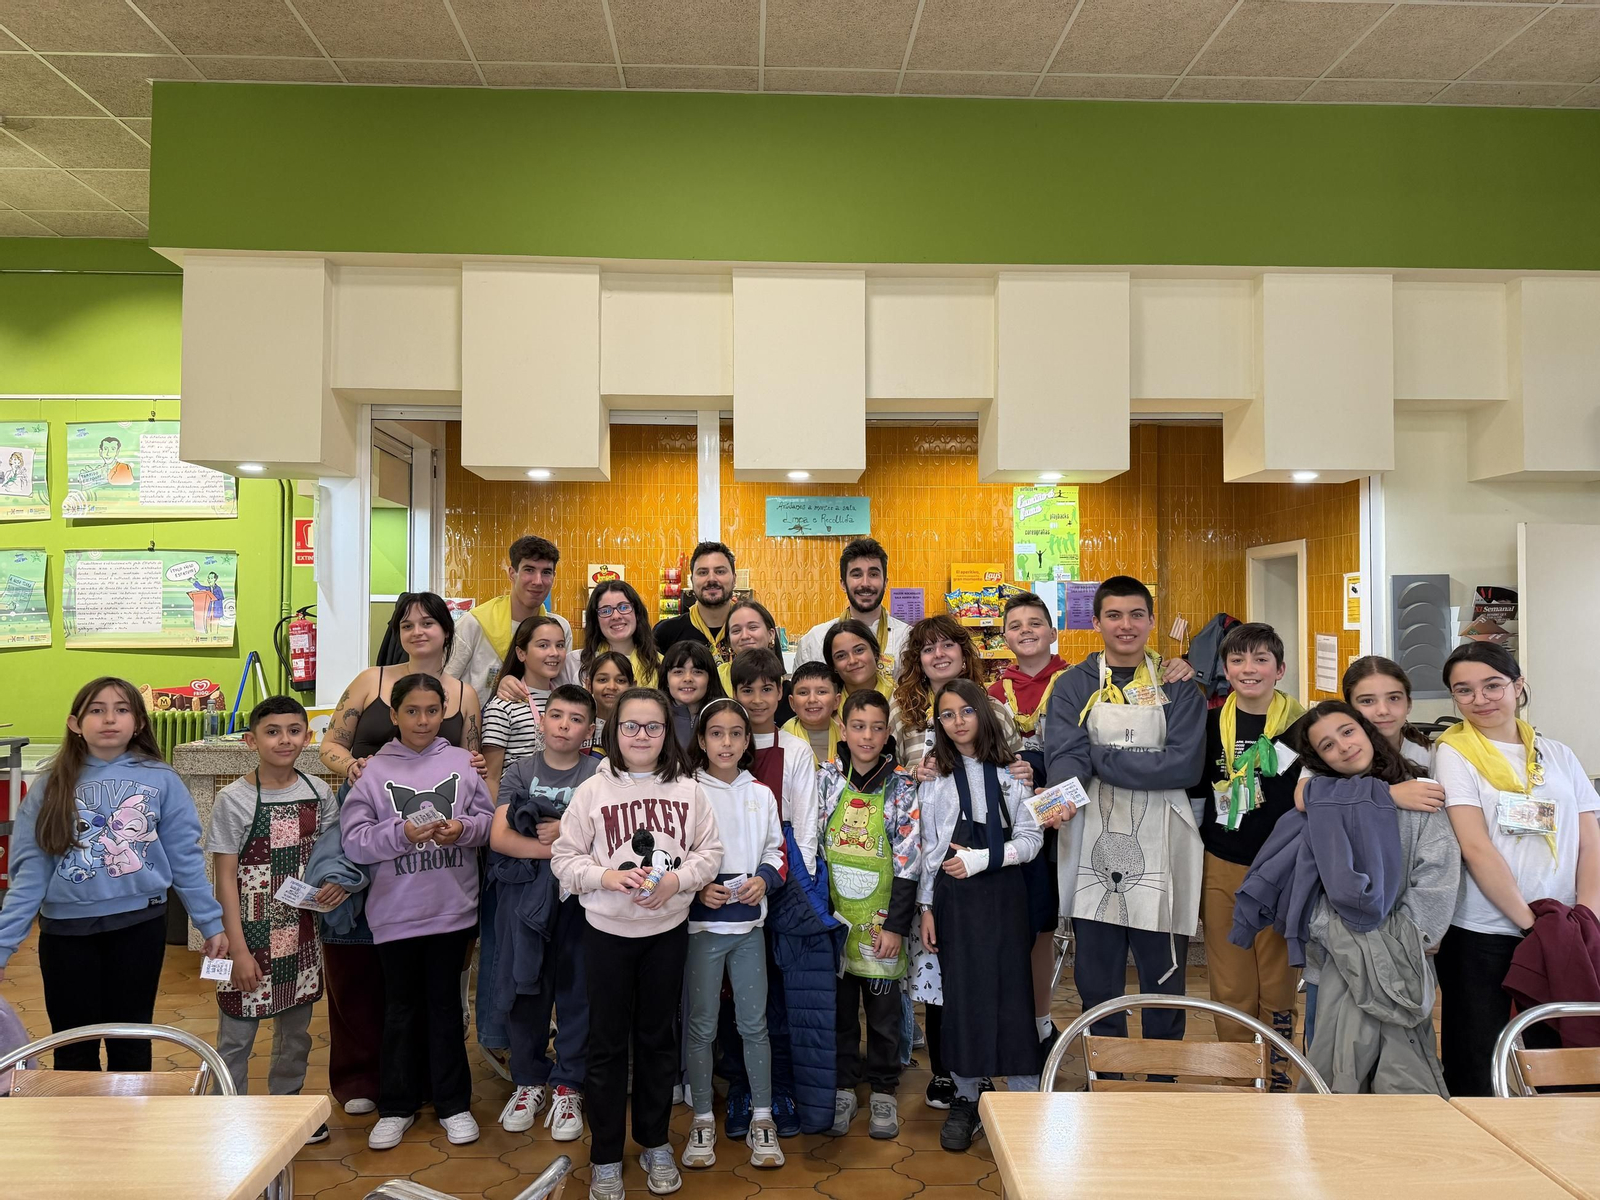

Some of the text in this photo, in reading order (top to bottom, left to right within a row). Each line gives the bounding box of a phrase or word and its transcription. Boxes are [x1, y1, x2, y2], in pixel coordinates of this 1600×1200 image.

[1125, 728, 1135, 743] BE
[76, 779, 160, 811] OVE
[600, 798, 690, 859] MICKEY
[394, 847, 464, 876] KUROMI
